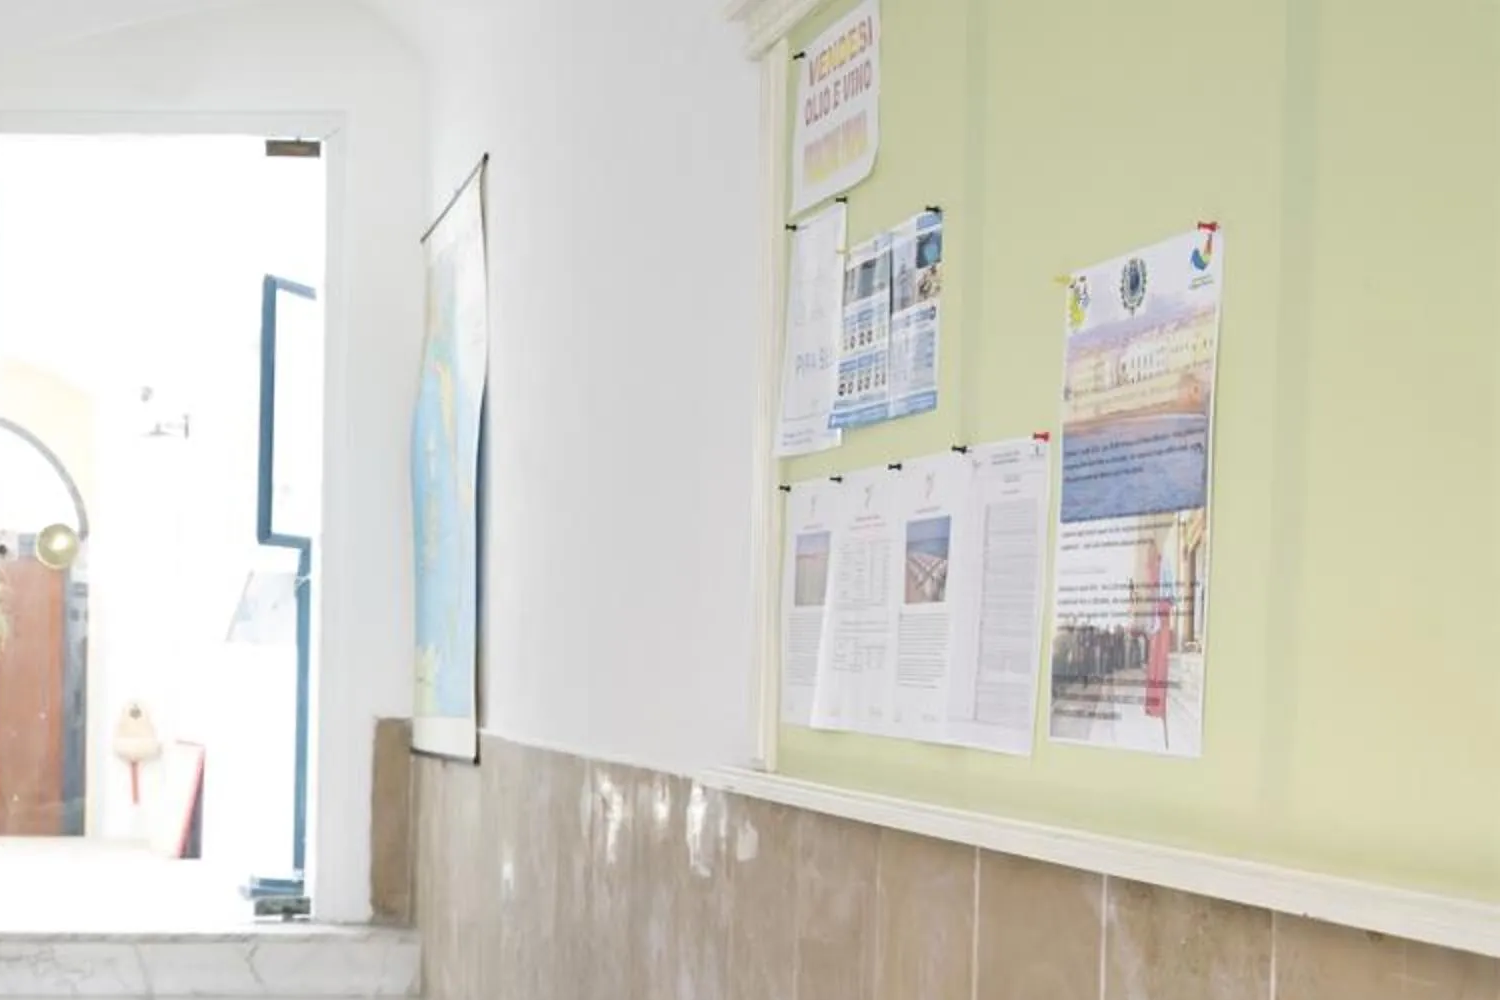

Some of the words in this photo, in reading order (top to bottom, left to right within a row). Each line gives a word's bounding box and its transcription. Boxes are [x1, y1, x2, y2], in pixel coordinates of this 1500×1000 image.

[808, 16, 874, 87] VENDESI
[804, 86, 832, 127] OLIO
[833, 80, 842, 110] E
[842, 60, 873, 103] VINO
